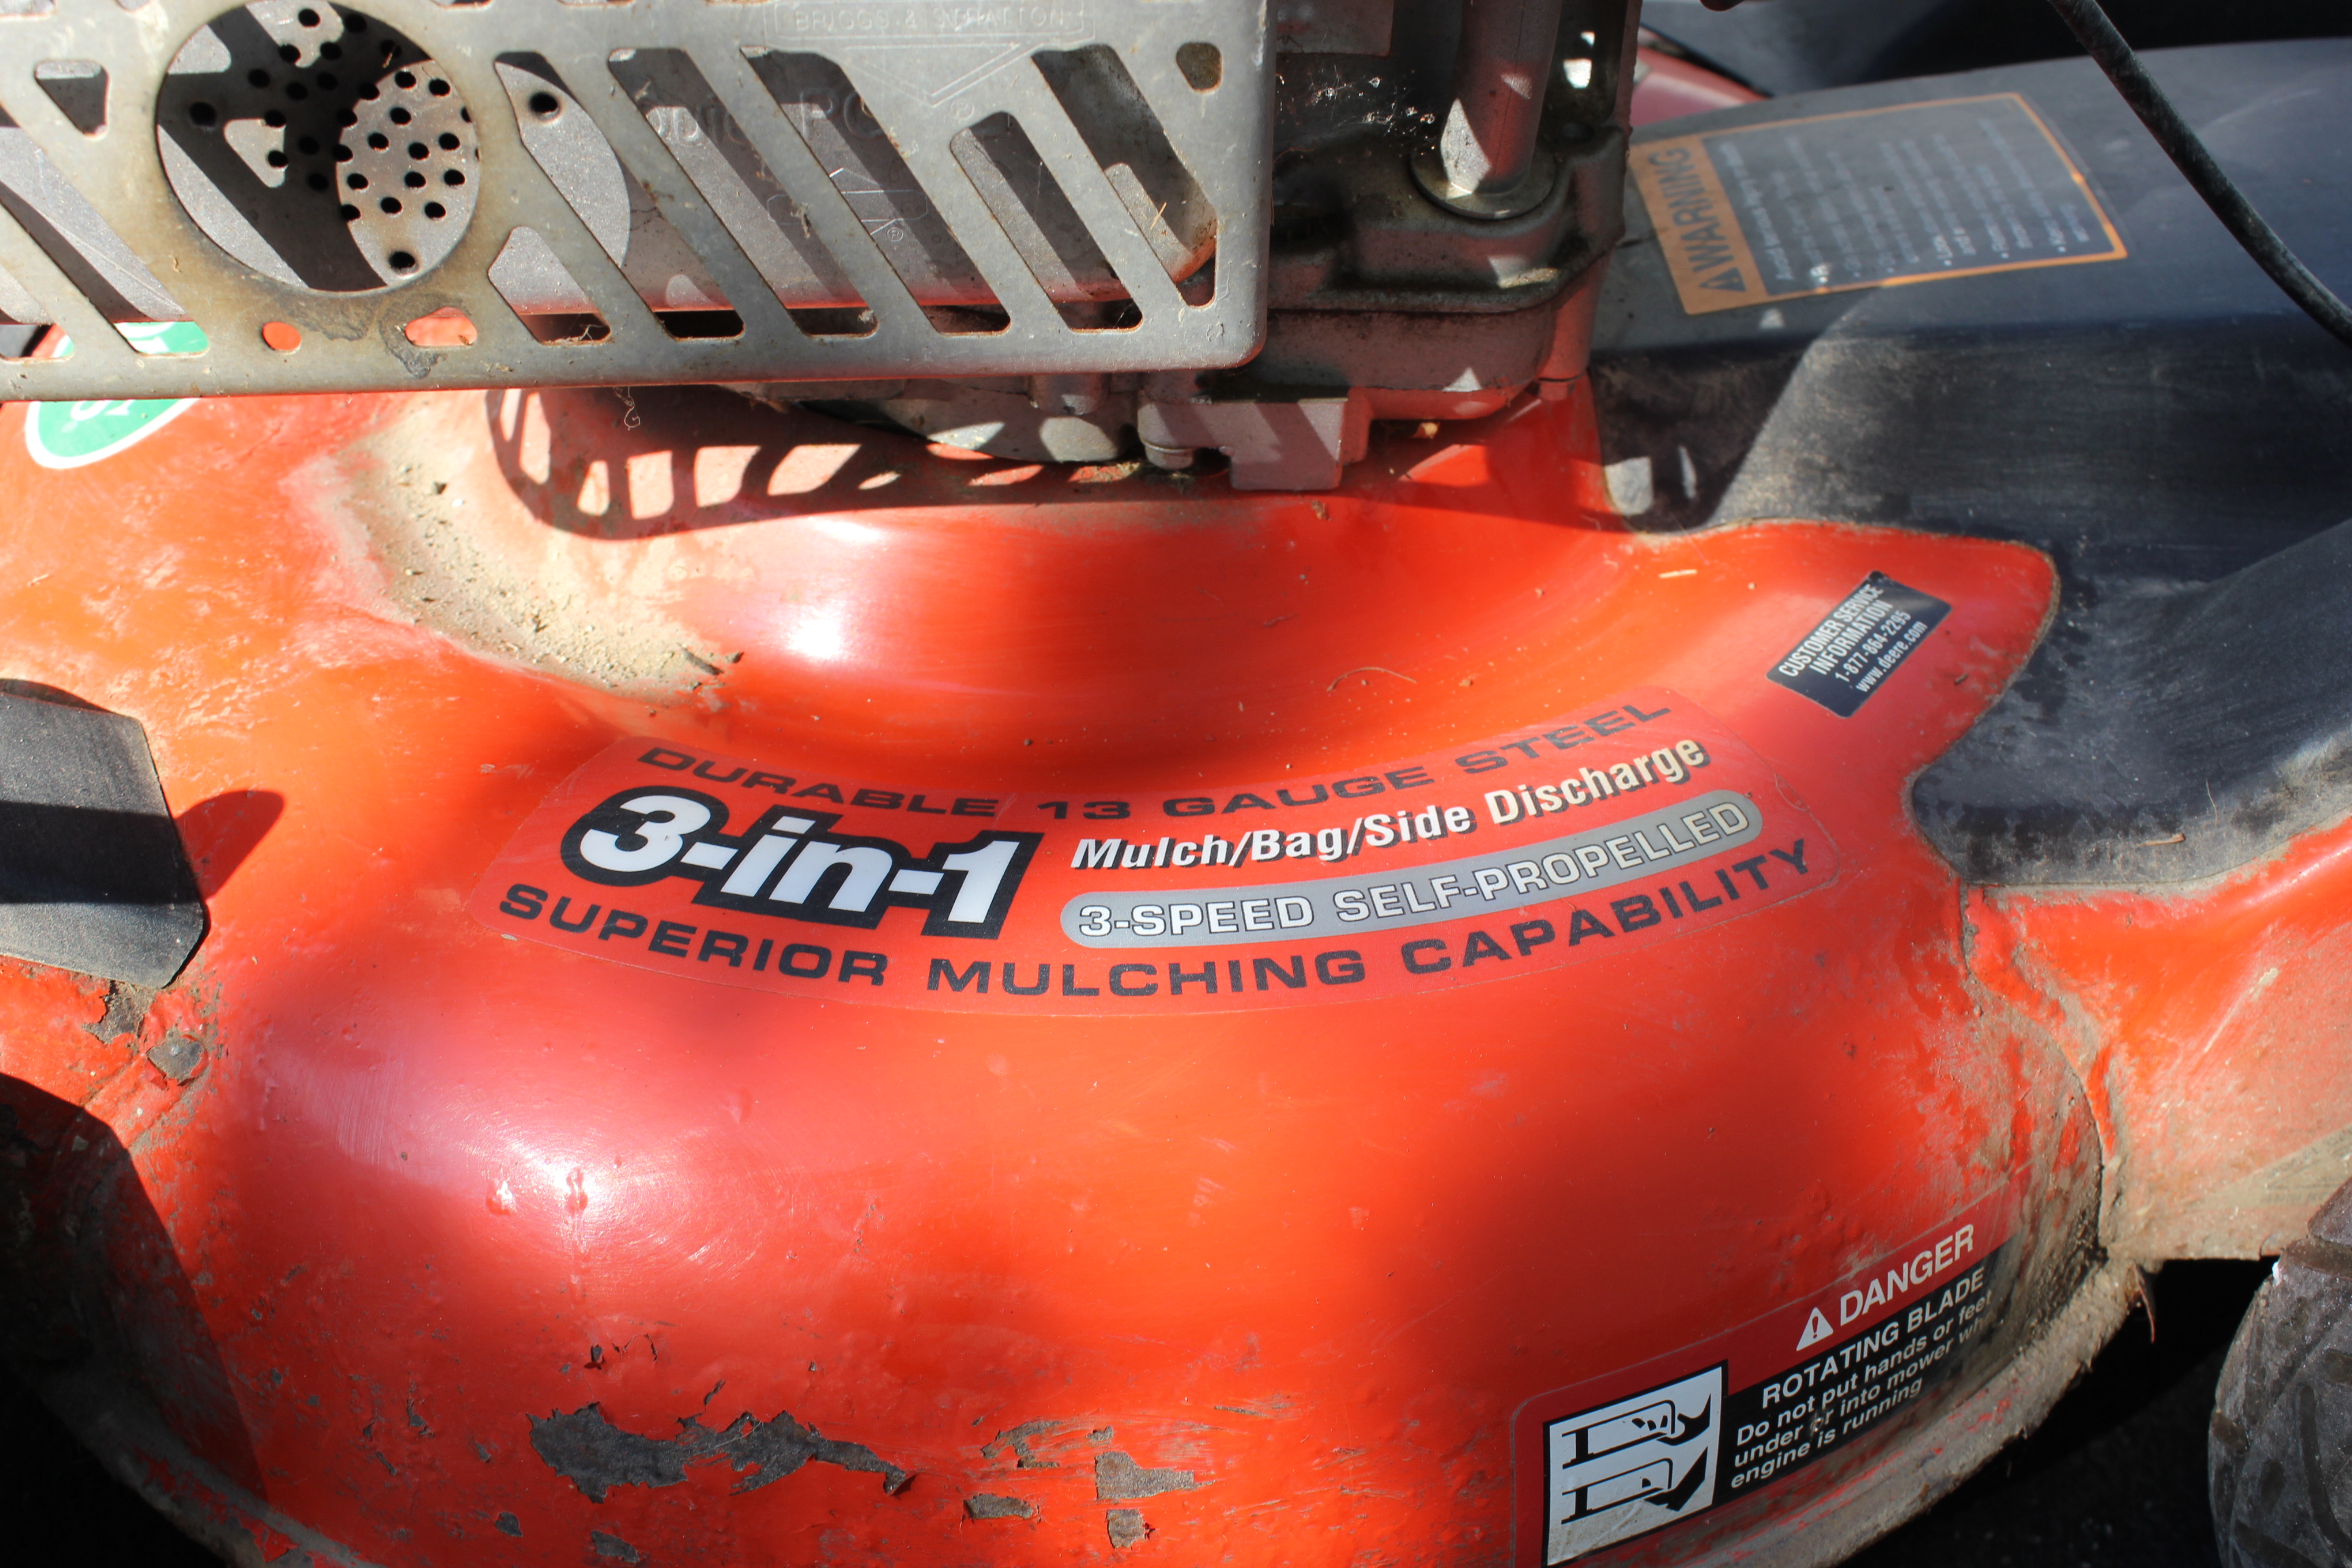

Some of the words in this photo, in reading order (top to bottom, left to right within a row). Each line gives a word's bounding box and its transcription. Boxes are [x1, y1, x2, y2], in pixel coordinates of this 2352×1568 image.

[795, 8, 889, 31] BRIGGS
[905, 8, 917, 29] &
[1648, 146, 1734, 272] WARNING
[1778, 619, 1845, 677] CUSTOMER
[1833, 584, 1884, 622] SERVICE
[1809, 600, 1893, 675] INFORMATION
[1835, 610, 1911, 683] 1-877-864-2295
[1856, 621, 1927, 693] www.deere.com
[637, 747, 999, 817] DURABLE
[1036, 800, 1130, 821] 13
[1162, 766, 1435, 817] GAUGE
[1455, 704, 1671, 774] STEEL
[1071, 805, 1473, 869] Mulch/Bag/Side
[1484, 738, 1708, 826] Discharge
[499, 883, 888, 985] SUPERIOR
[927, 950, 1365, 996] MULCHING
[1401, 838, 1809, 975] CAPABILITY
[570, 790, 1033, 931] 3-in-1
[1079, 896, 1314, 936] 3-SPEED
[1333, 802, 1750, 921] SELF-PROPELLED
[1840, 1224, 1974, 1326] DANGER
[1737, 1421, 1769, 1446] Do
[1778, 1396, 1815, 1427] not
[1822, 1373, 1858, 1409] put
[1865, 1335, 1927, 1383] hands
[1933, 1319, 1954, 1341] or
[1959, 1290, 1992, 1325] feet
[1763, 1322, 1899, 1409] ROTATING
[1908, 1267, 1984, 1333] BLADE
[1731, 1442, 1810, 1488] engine
[1818, 1429, 1835, 1448] is
[1843, 1377, 1923, 1435] running
[1734, 1425, 1803, 1467] under
[1840, 1384, 1880, 1417] into
[1887, 1338, 1954, 1390] mower
